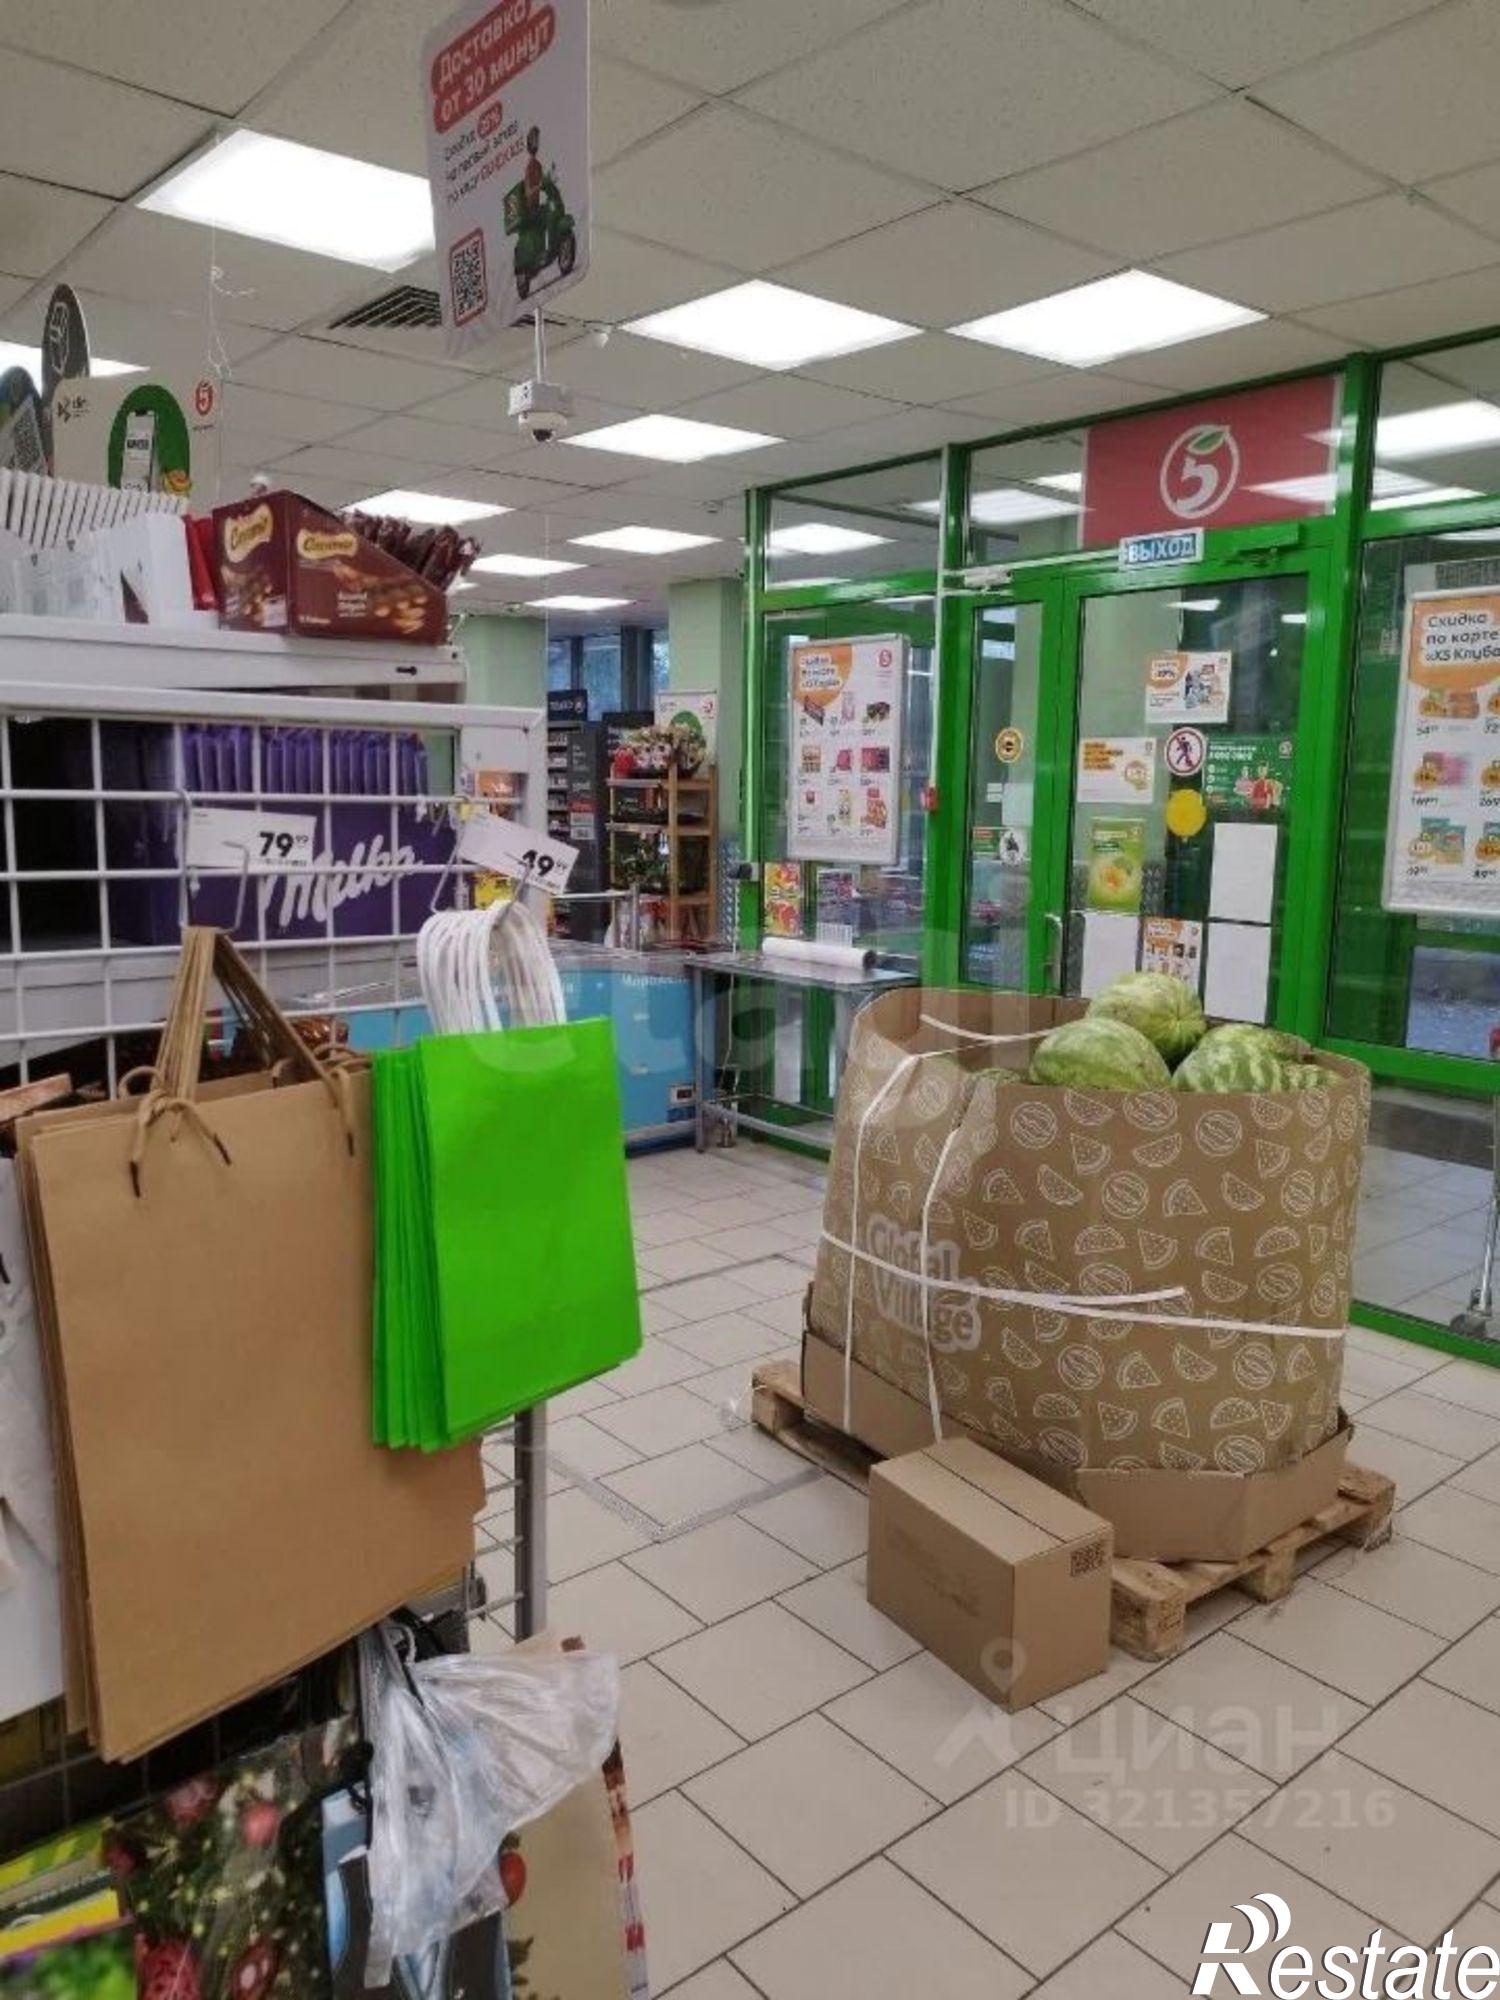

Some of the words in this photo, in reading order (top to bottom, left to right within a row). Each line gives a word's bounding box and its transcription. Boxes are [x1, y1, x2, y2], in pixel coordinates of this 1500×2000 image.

[439, 0, 525, 92] Доставка
[441, 91, 461, 122] от
[464, 67, 485, 103] 30
[488, 15, 550, 84] минут
[1128, 536, 1194, 563] ВЫХОД
[1428, 612, 1487, 627] Скидка
[1426, 635, 1446, 645] по
[1451, 630, 1499, 645] карте
[259, 831, 294, 857] 79
[256, 834, 424, 928] Milka
